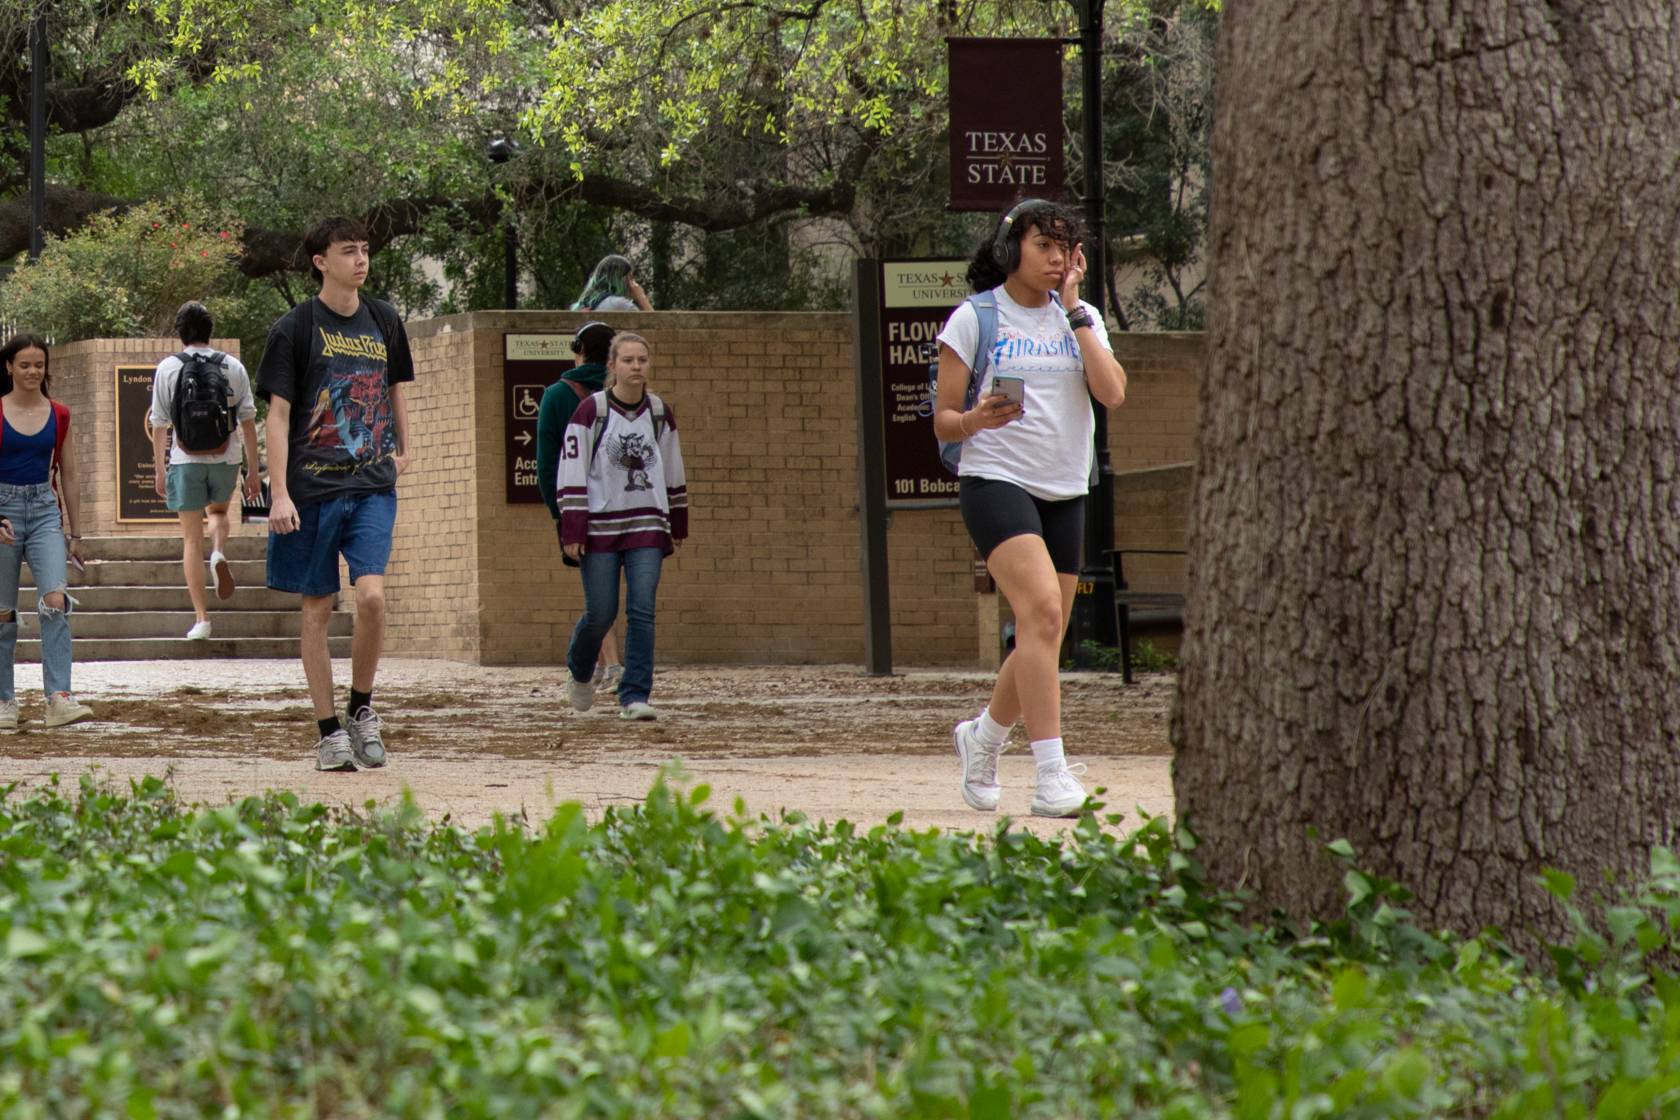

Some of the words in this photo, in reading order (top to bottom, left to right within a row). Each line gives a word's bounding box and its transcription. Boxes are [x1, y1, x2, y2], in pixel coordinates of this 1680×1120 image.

[965, 131, 1047, 153] TEXAS
[968, 164, 1046, 185] STATE
[897, 272, 938, 284] TEXAS
[888, 321, 946, 342] FLOW
[515, 339, 538, 347] TEXAS
[994, 333, 1081, 366] THRASHE
[123, 375, 152, 385] Lyndon
[891, 383, 915, 392] College
[917, 382, 924, 391] of
[892, 414, 917, 423] English
[894, 478, 915, 494] 101
[920, 478, 960, 493] Bobca
